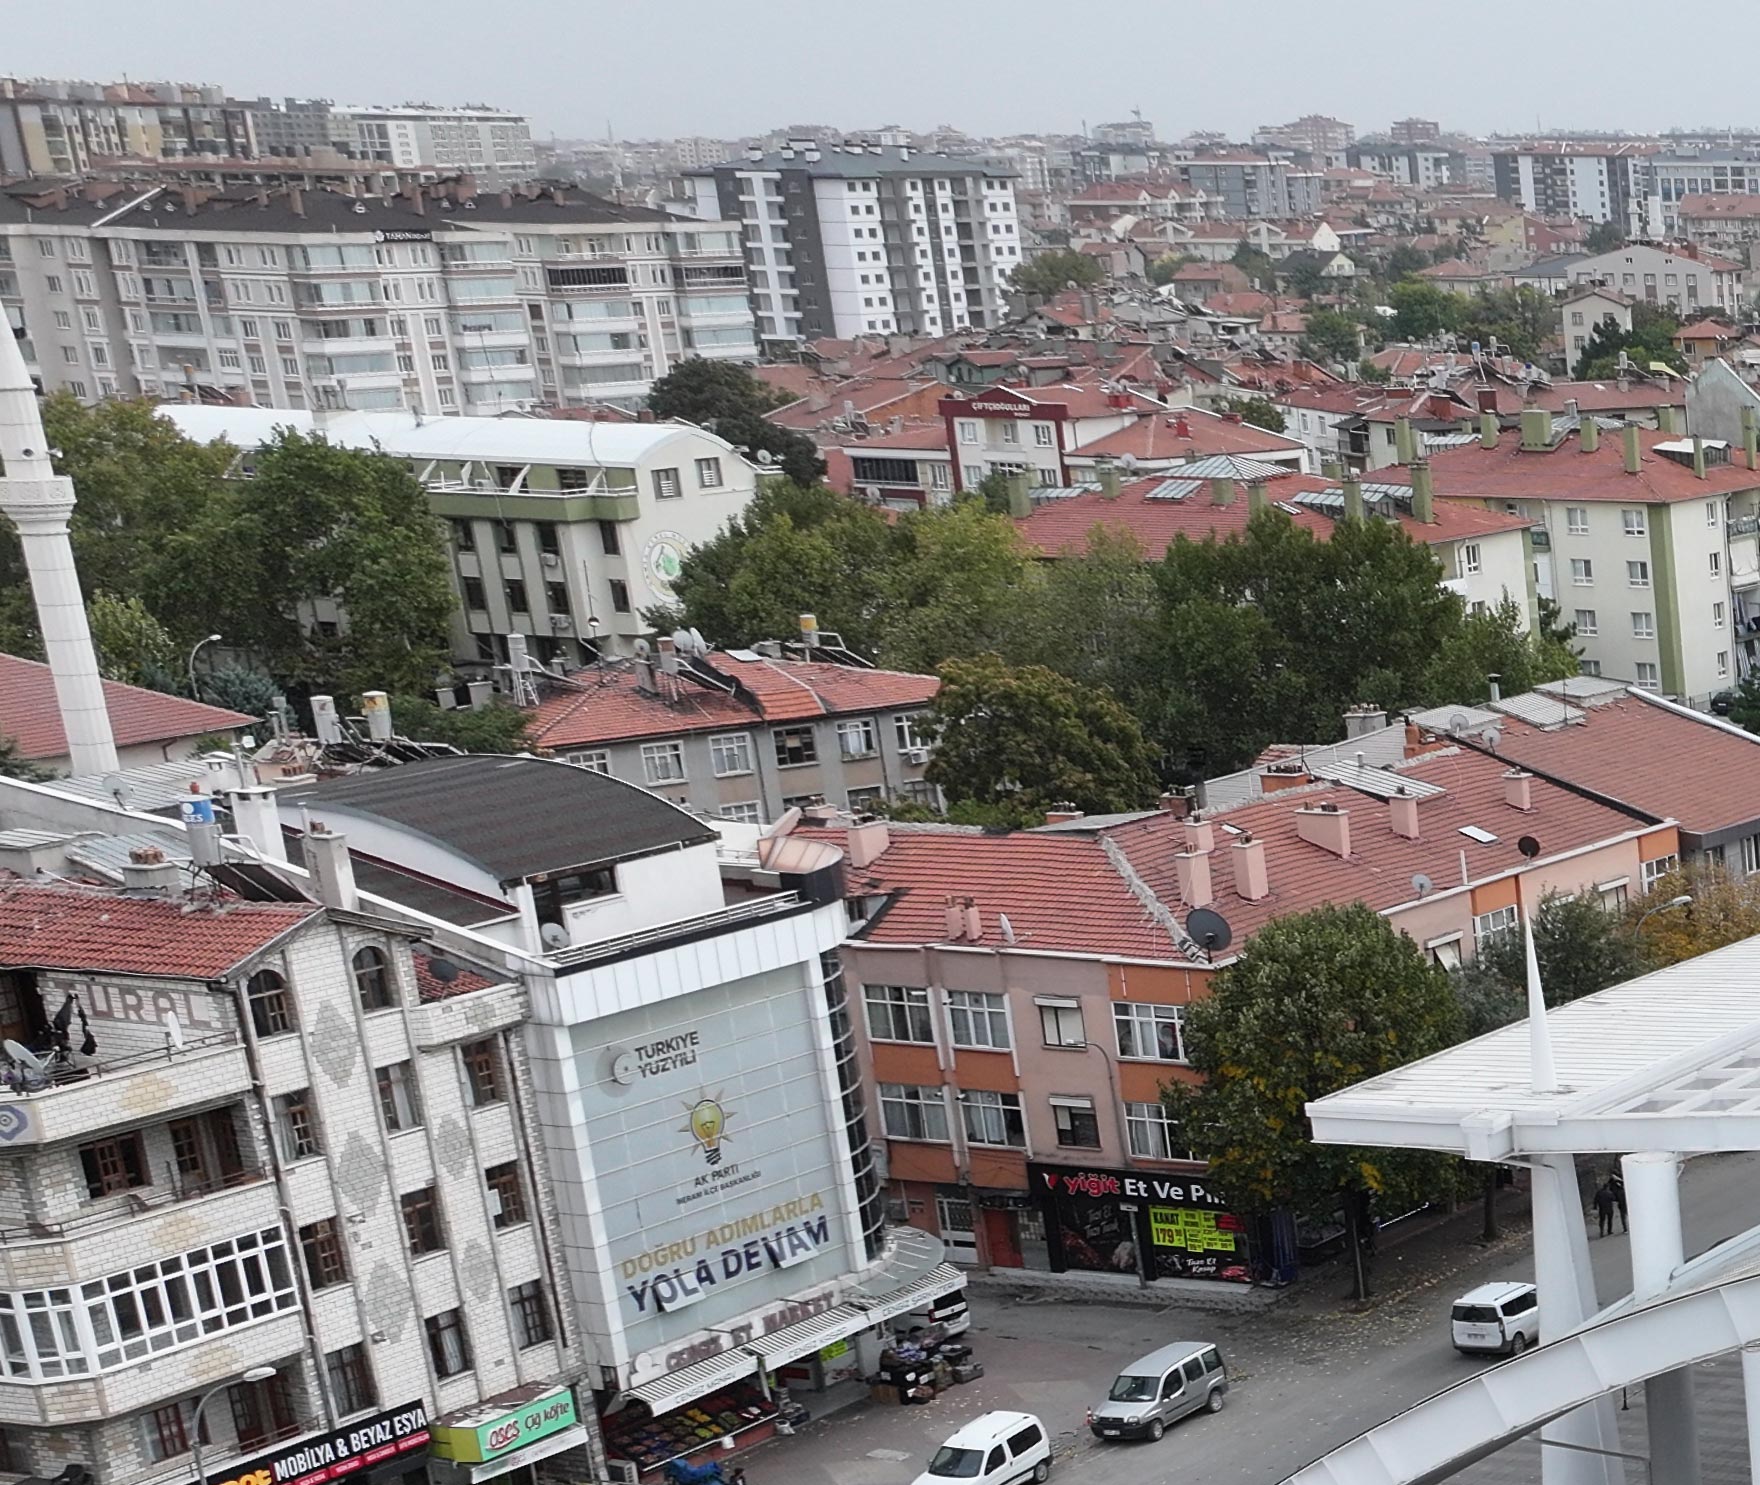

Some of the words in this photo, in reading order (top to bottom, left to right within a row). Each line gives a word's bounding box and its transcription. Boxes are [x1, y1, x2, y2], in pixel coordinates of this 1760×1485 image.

[634, 1030, 700, 1062] TÜRKİYE
[693, 1172, 711, 1188] AK
[1124, 1178, 1149, 1198] Et
[1152, 1181, 1184, 1200] Ve
[621, 1236, 698, 1280] DOĞRU
[705, 1192, 825, 1250] ADIMLARLA
[626, 1258, 718, 1313] YOLA
[720, 1214, 831, 1281] DEVAM
[543, 1402, 571, 1422] köfte
[273, 1446, 336, 1482] MOBİLYA
[336, 1437, 351, 1459] &
[349, 1419, 394, 1453] BEYAZ
[394, 1407, 428, 1437] EŞYA
